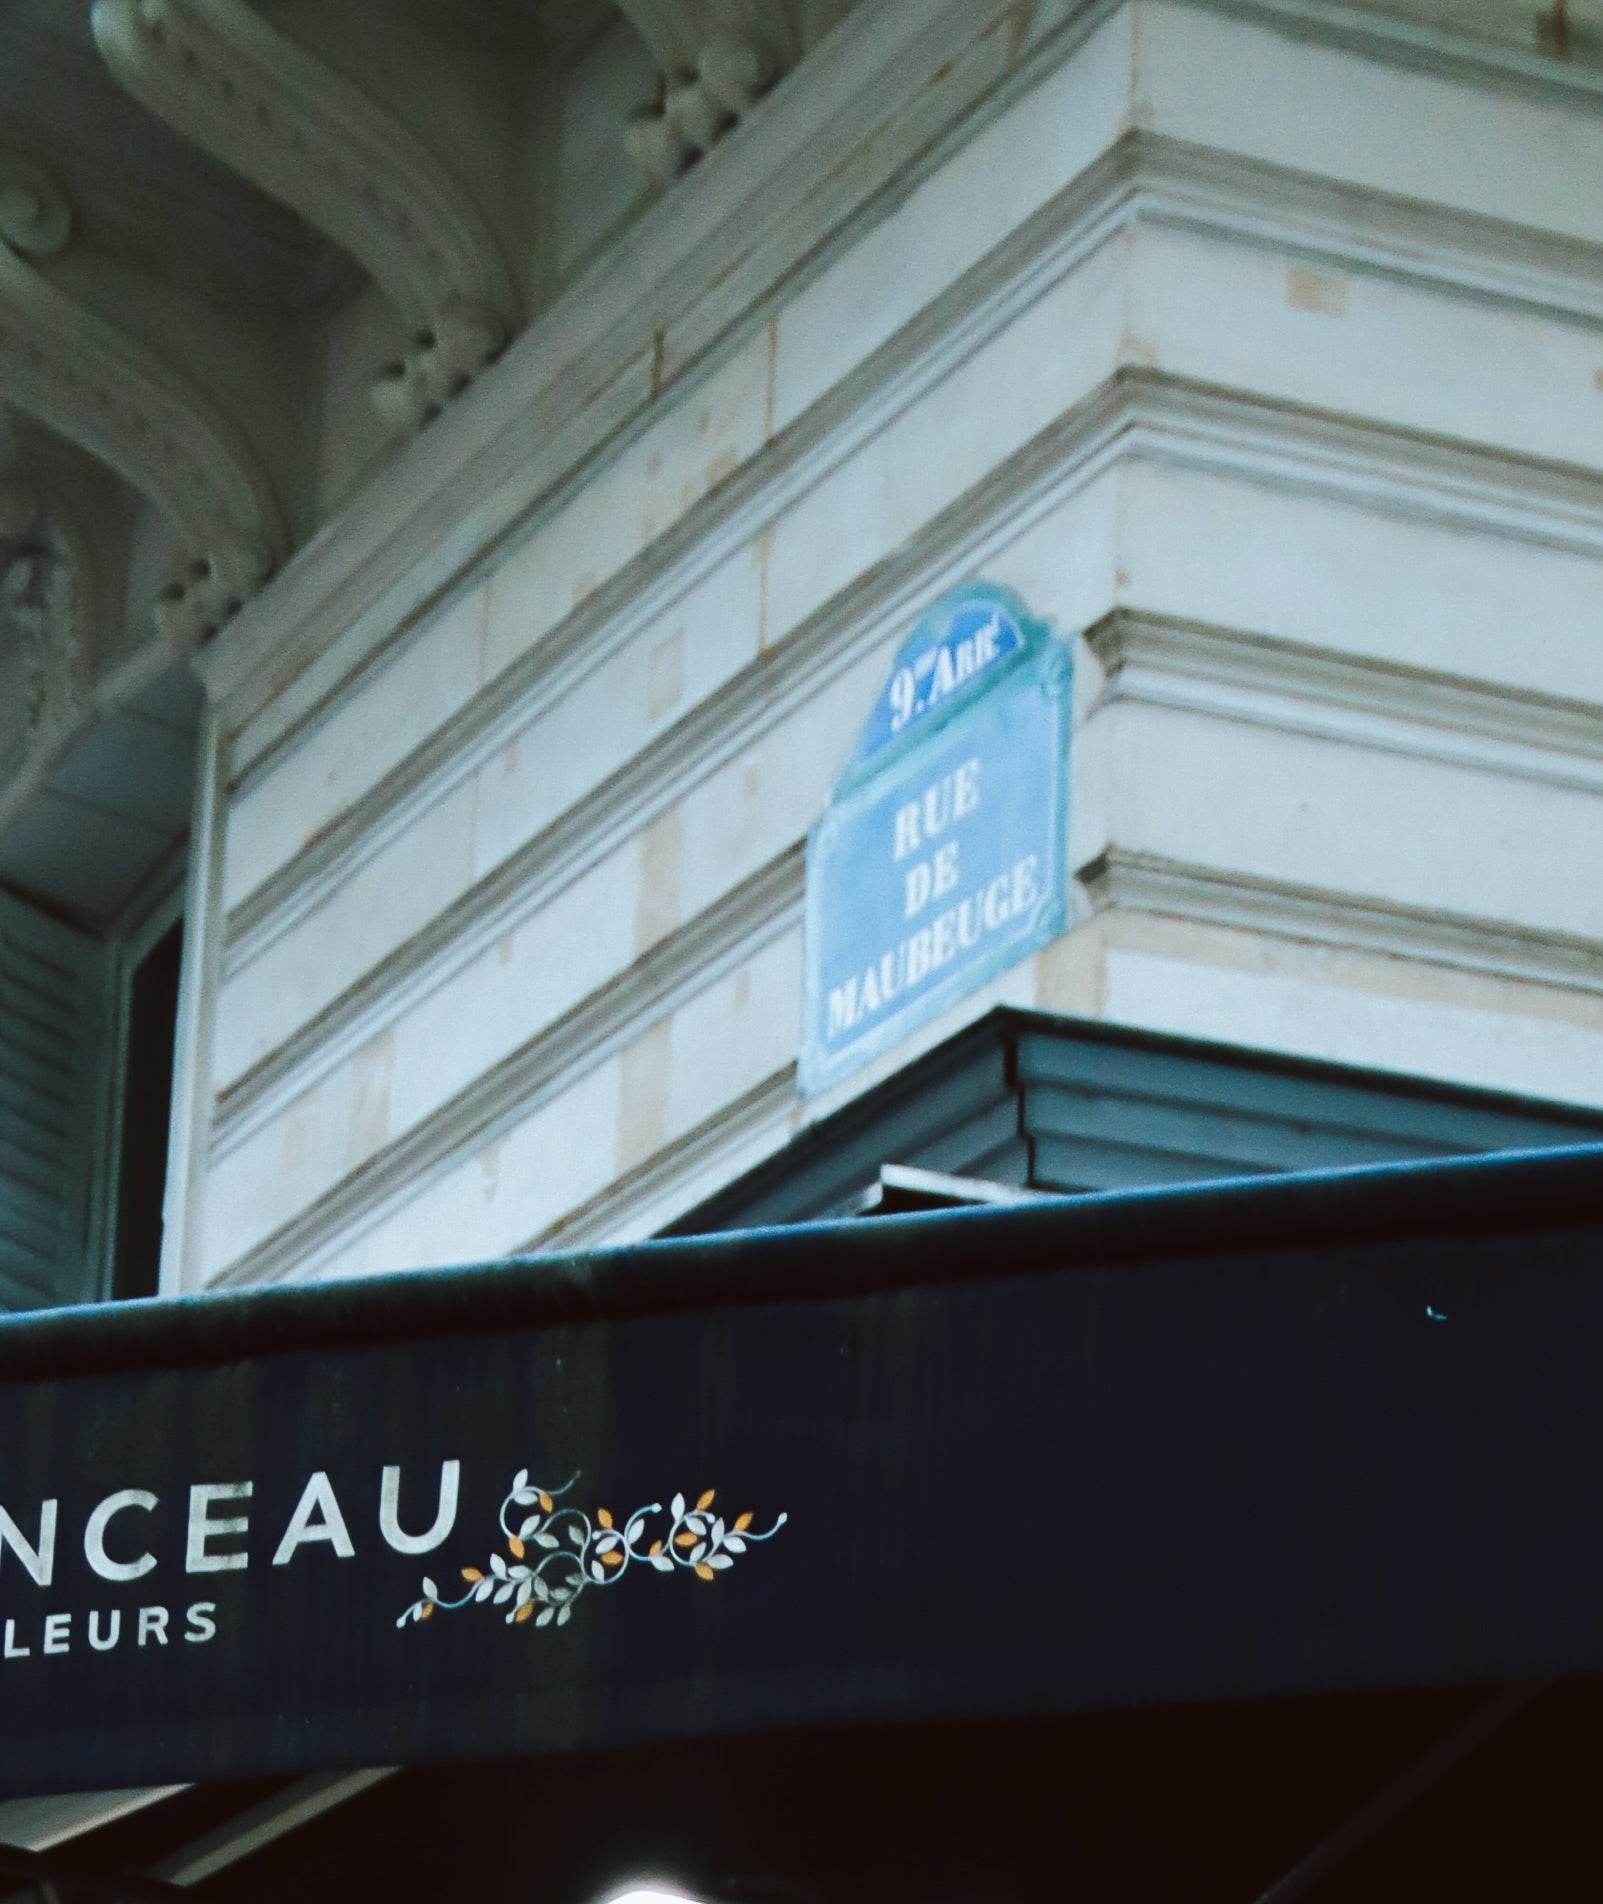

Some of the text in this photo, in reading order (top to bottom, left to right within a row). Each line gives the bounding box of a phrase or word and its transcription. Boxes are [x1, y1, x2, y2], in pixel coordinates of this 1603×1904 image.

[892, 757, 980, 863] RUE
[904, 839, 959, 918] DE
[826, 853, 1038, 1040] MAUBEUGE
